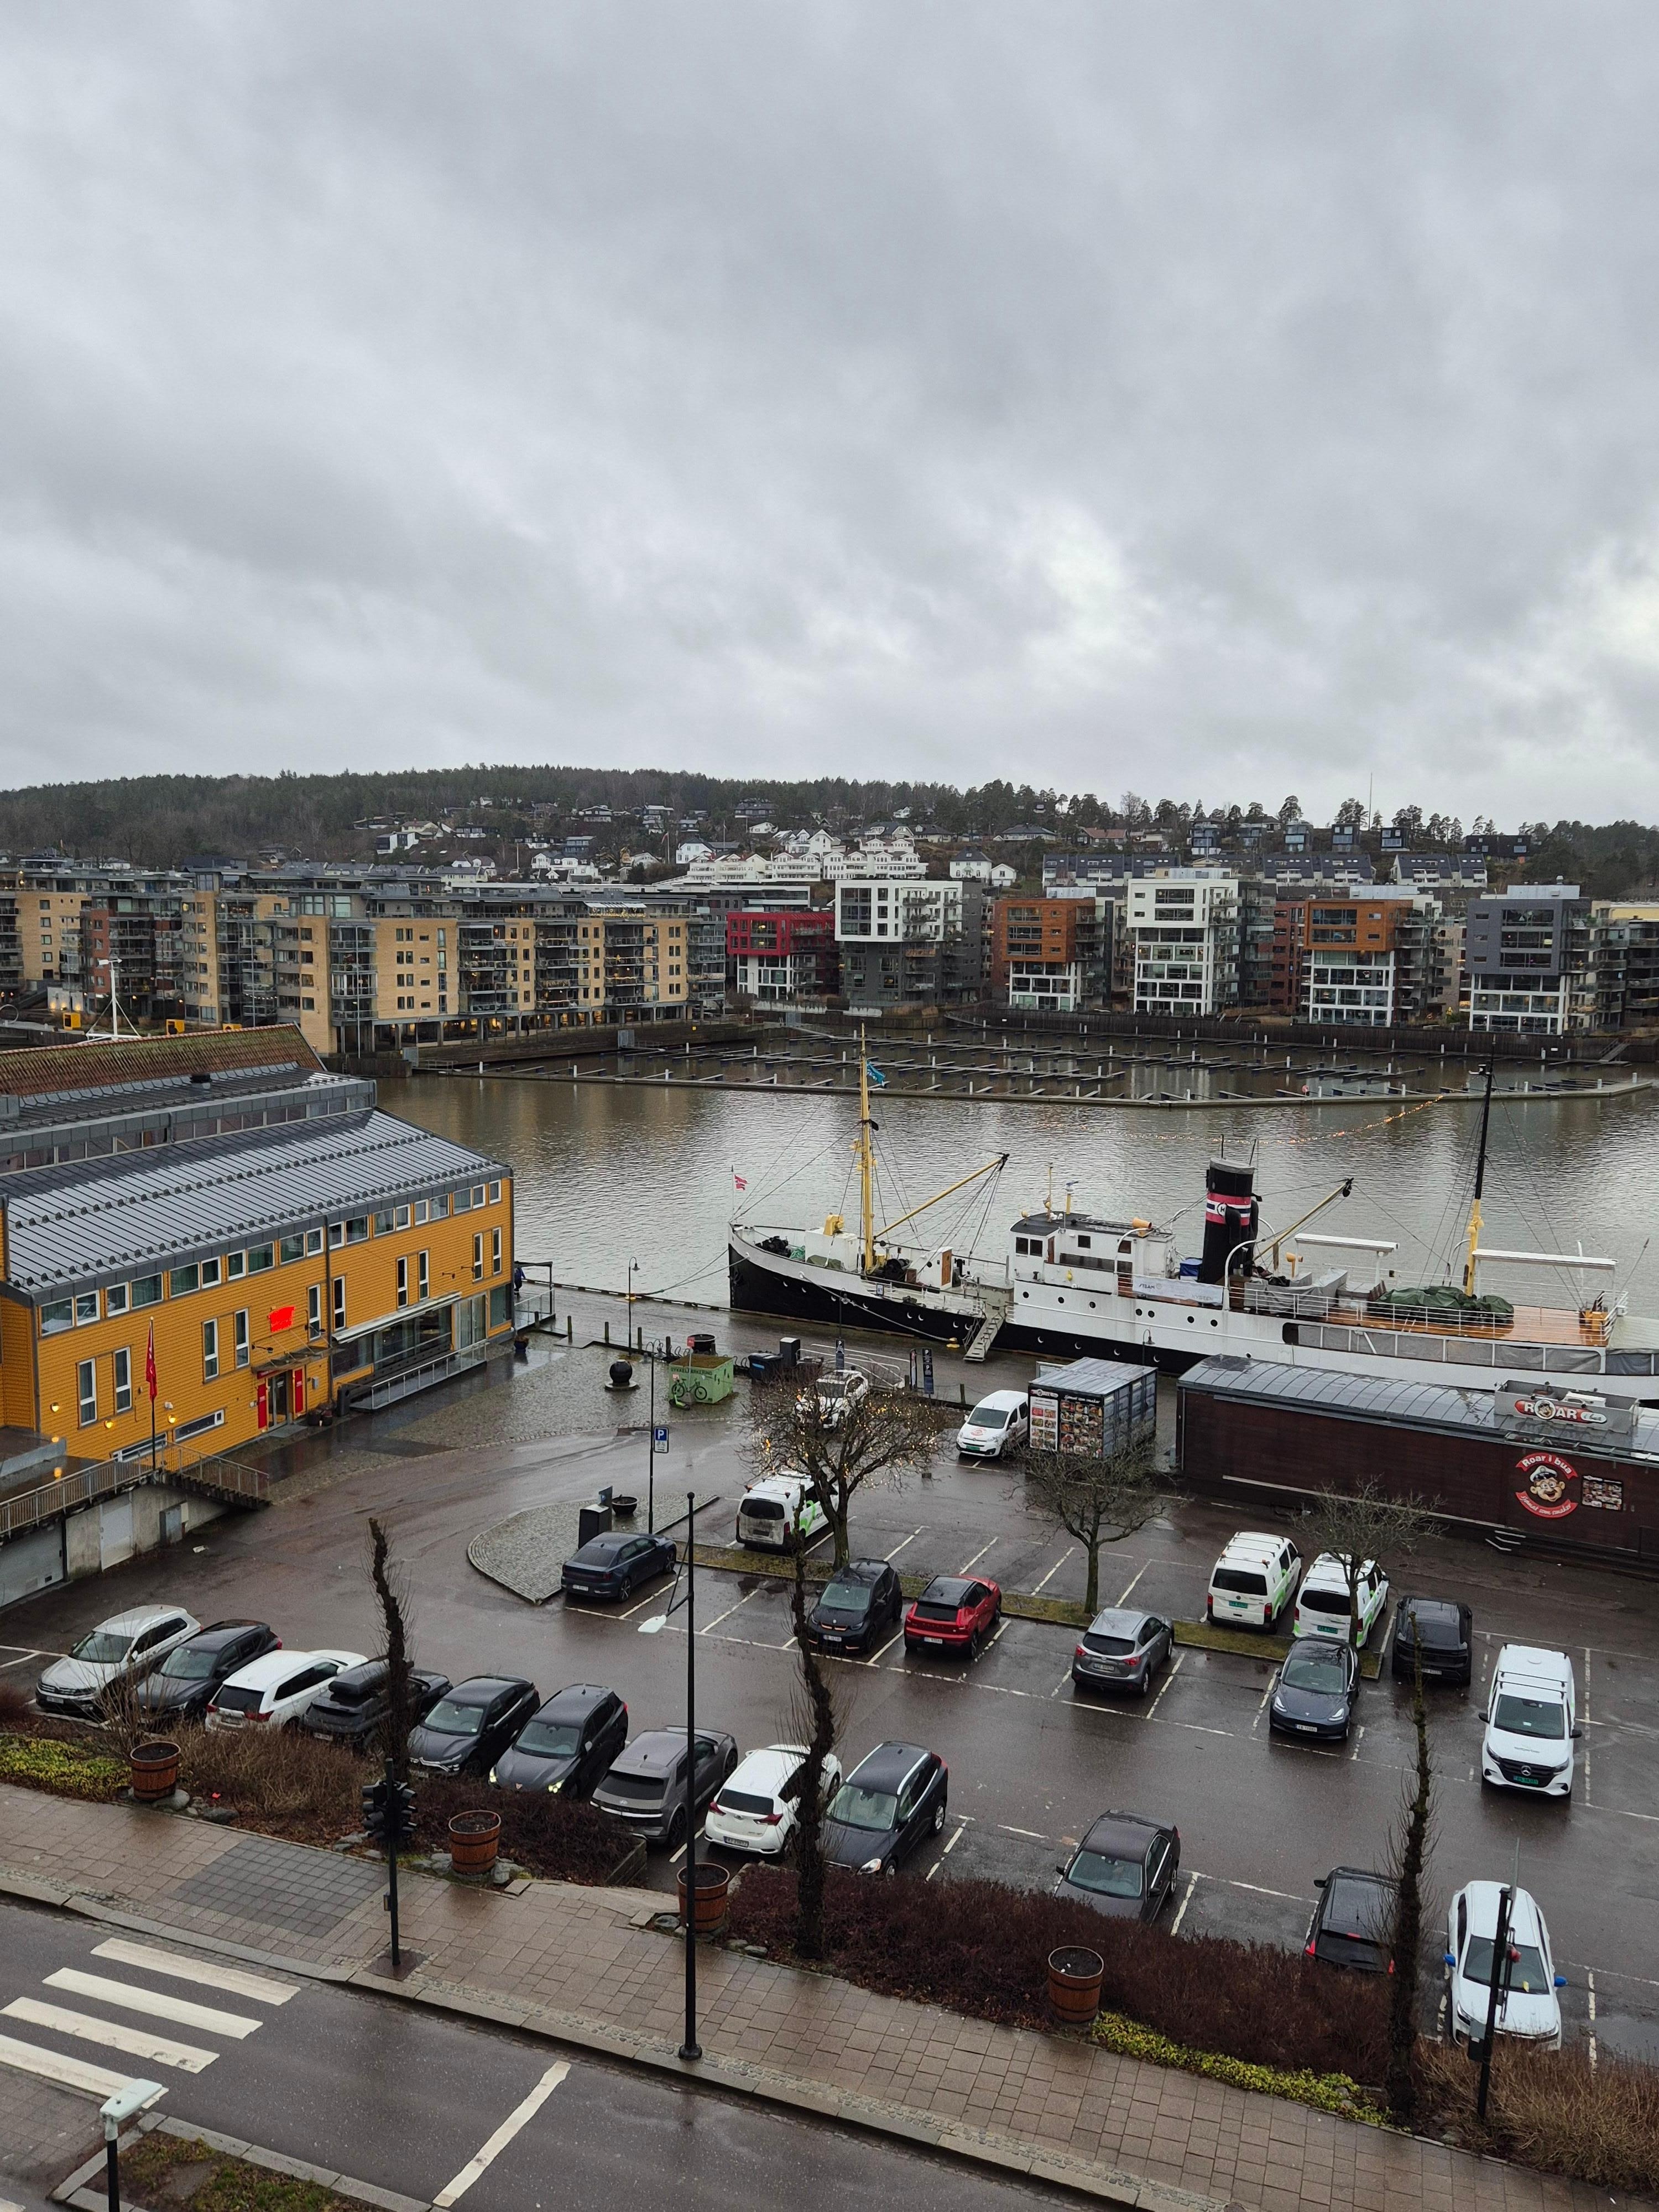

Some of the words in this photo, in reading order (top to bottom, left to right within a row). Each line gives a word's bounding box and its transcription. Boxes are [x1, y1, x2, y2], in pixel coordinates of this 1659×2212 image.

[658, 1429, 664, 1439] P
[1521, 1455, 1546, 1467] Roar
[1554, 1457, 1572, 1474] bua
